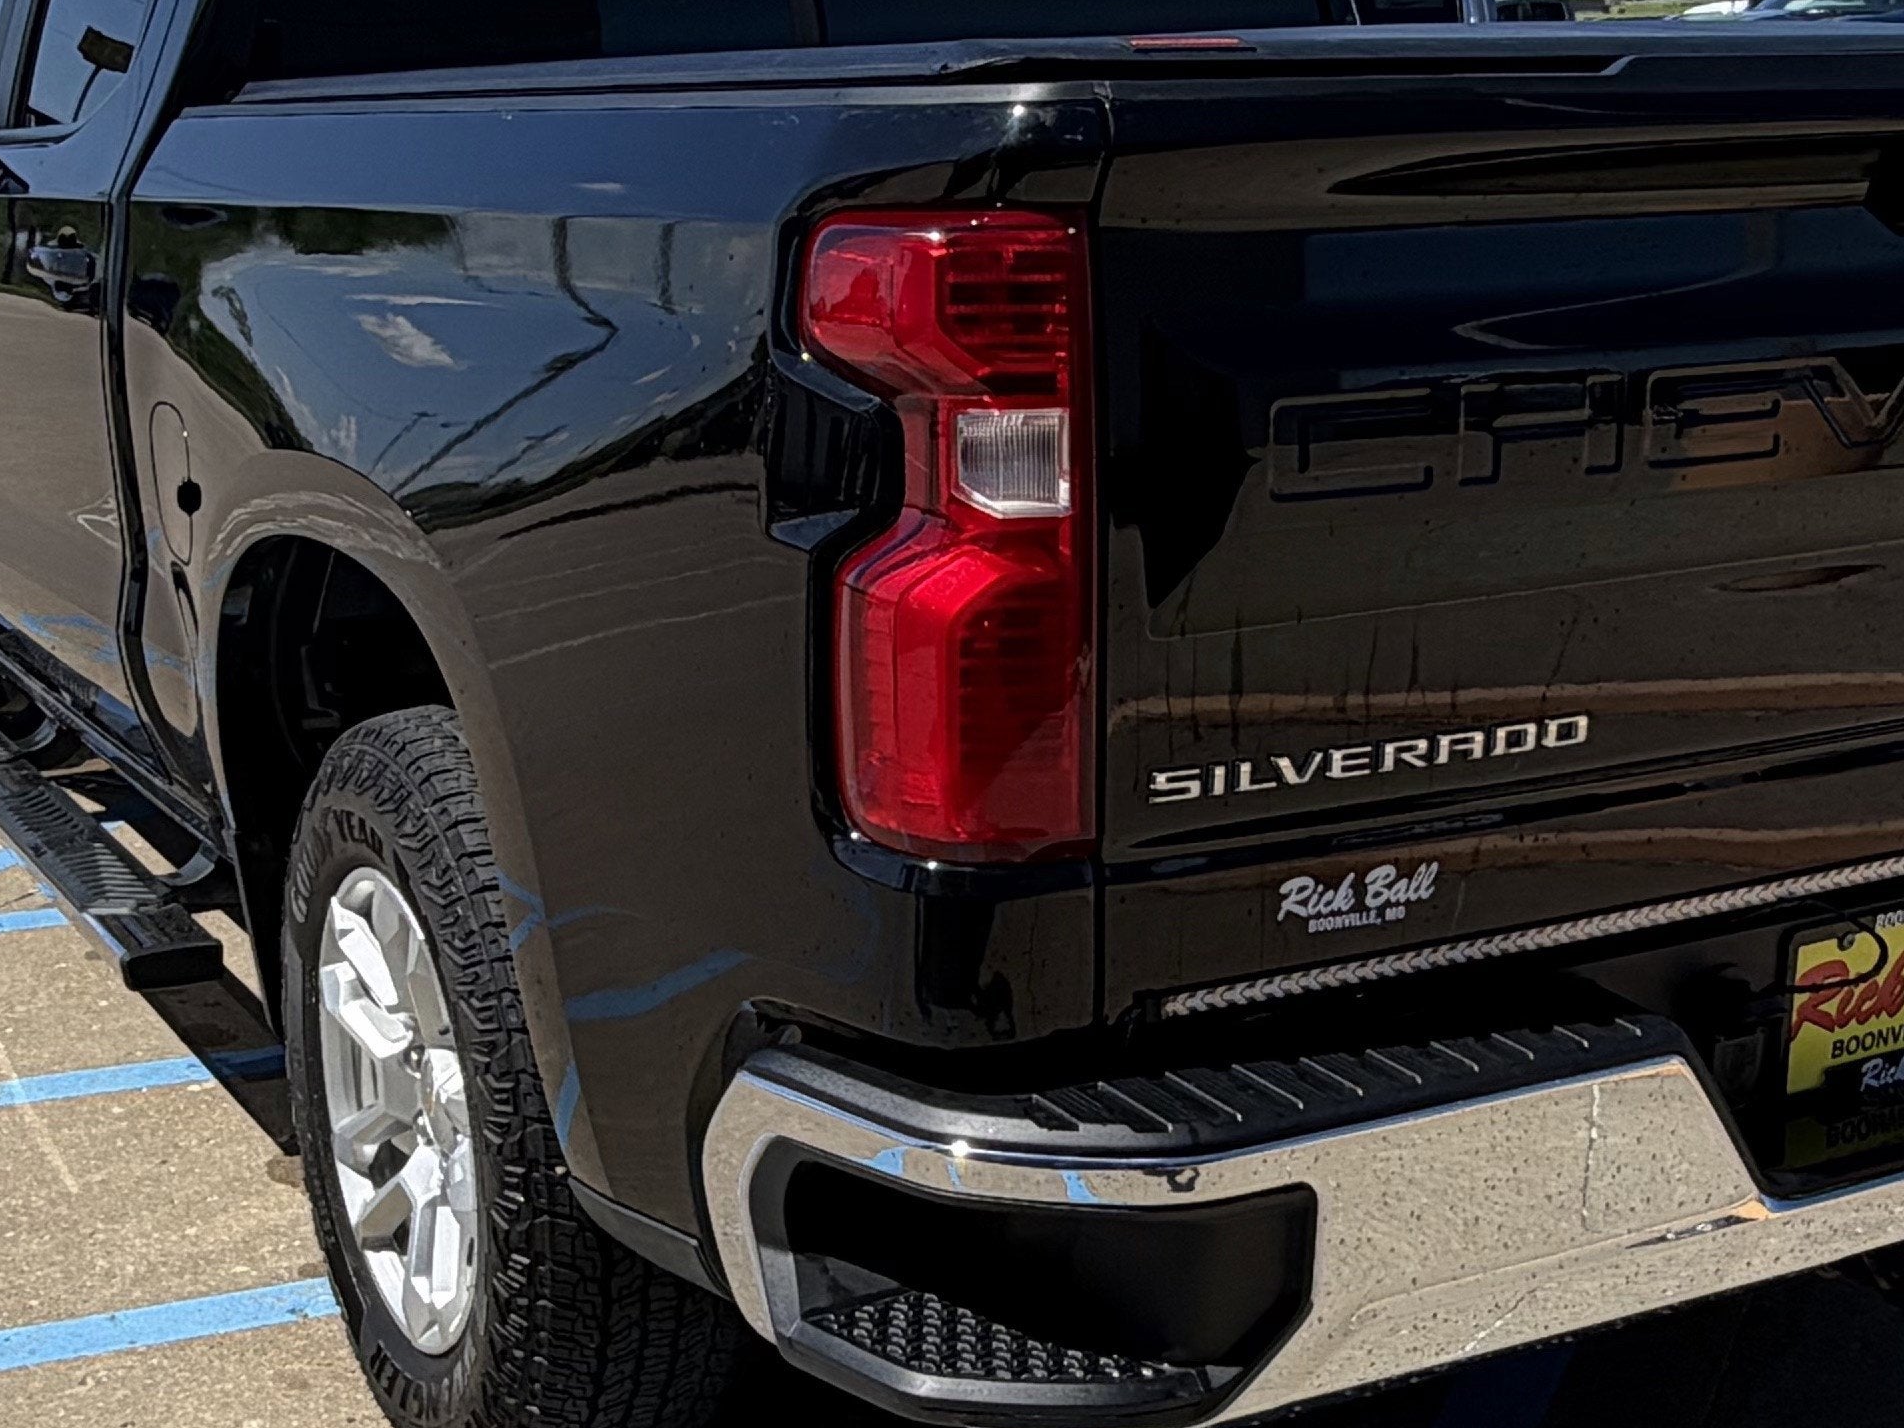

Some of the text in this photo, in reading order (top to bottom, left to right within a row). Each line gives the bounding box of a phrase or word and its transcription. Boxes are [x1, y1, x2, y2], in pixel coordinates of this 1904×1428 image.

[1148, 714, 1590, 805] SILVERADO
[1276, 861, 1440, 922] Rick Ball
[1308, 905, 1406, 934] BOONVILLE, MO
